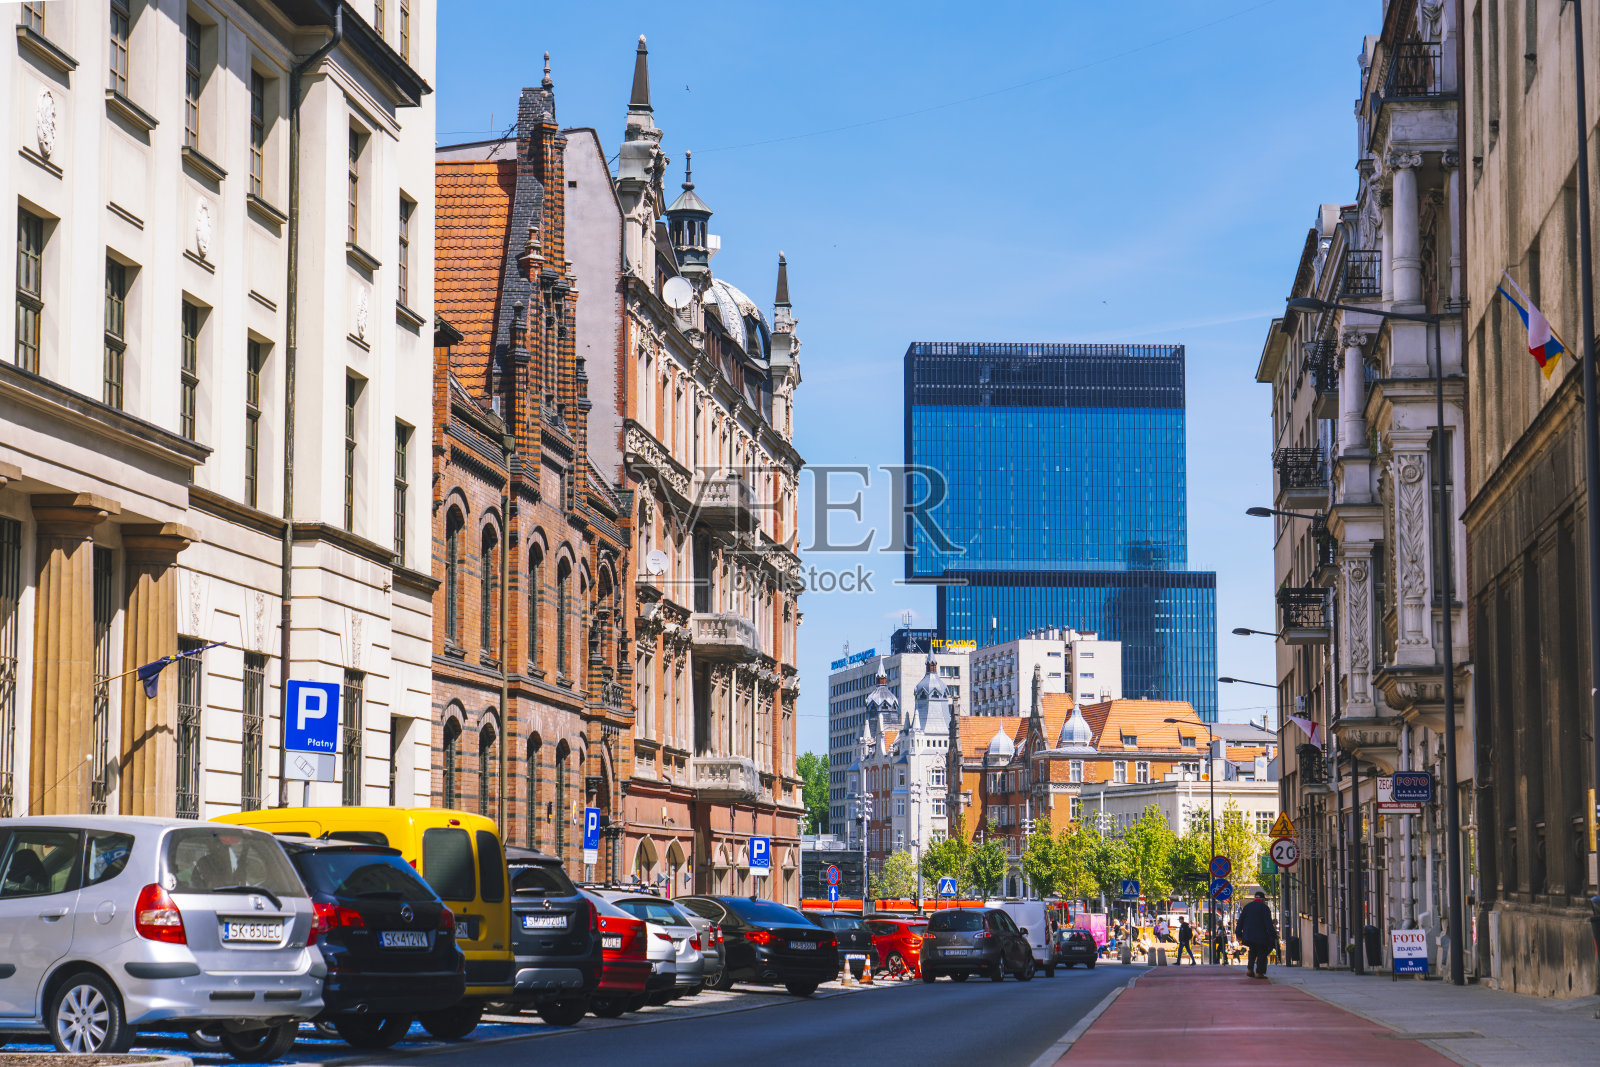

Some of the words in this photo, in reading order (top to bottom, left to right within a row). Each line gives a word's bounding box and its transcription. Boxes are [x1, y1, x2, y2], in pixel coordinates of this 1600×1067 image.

[945, 639, 977, 648] CASINO
[297, 687, 328, 730] P
[308, 738, 334, 749] Płatny
[1396, 777, 1428, 786] FOTO
[588, 812, 597, 838] P
[753, 840, 766, 858] P
[1276, 846, 1295, 860] 20
[1393, 934, 1425, 943] FOTO
